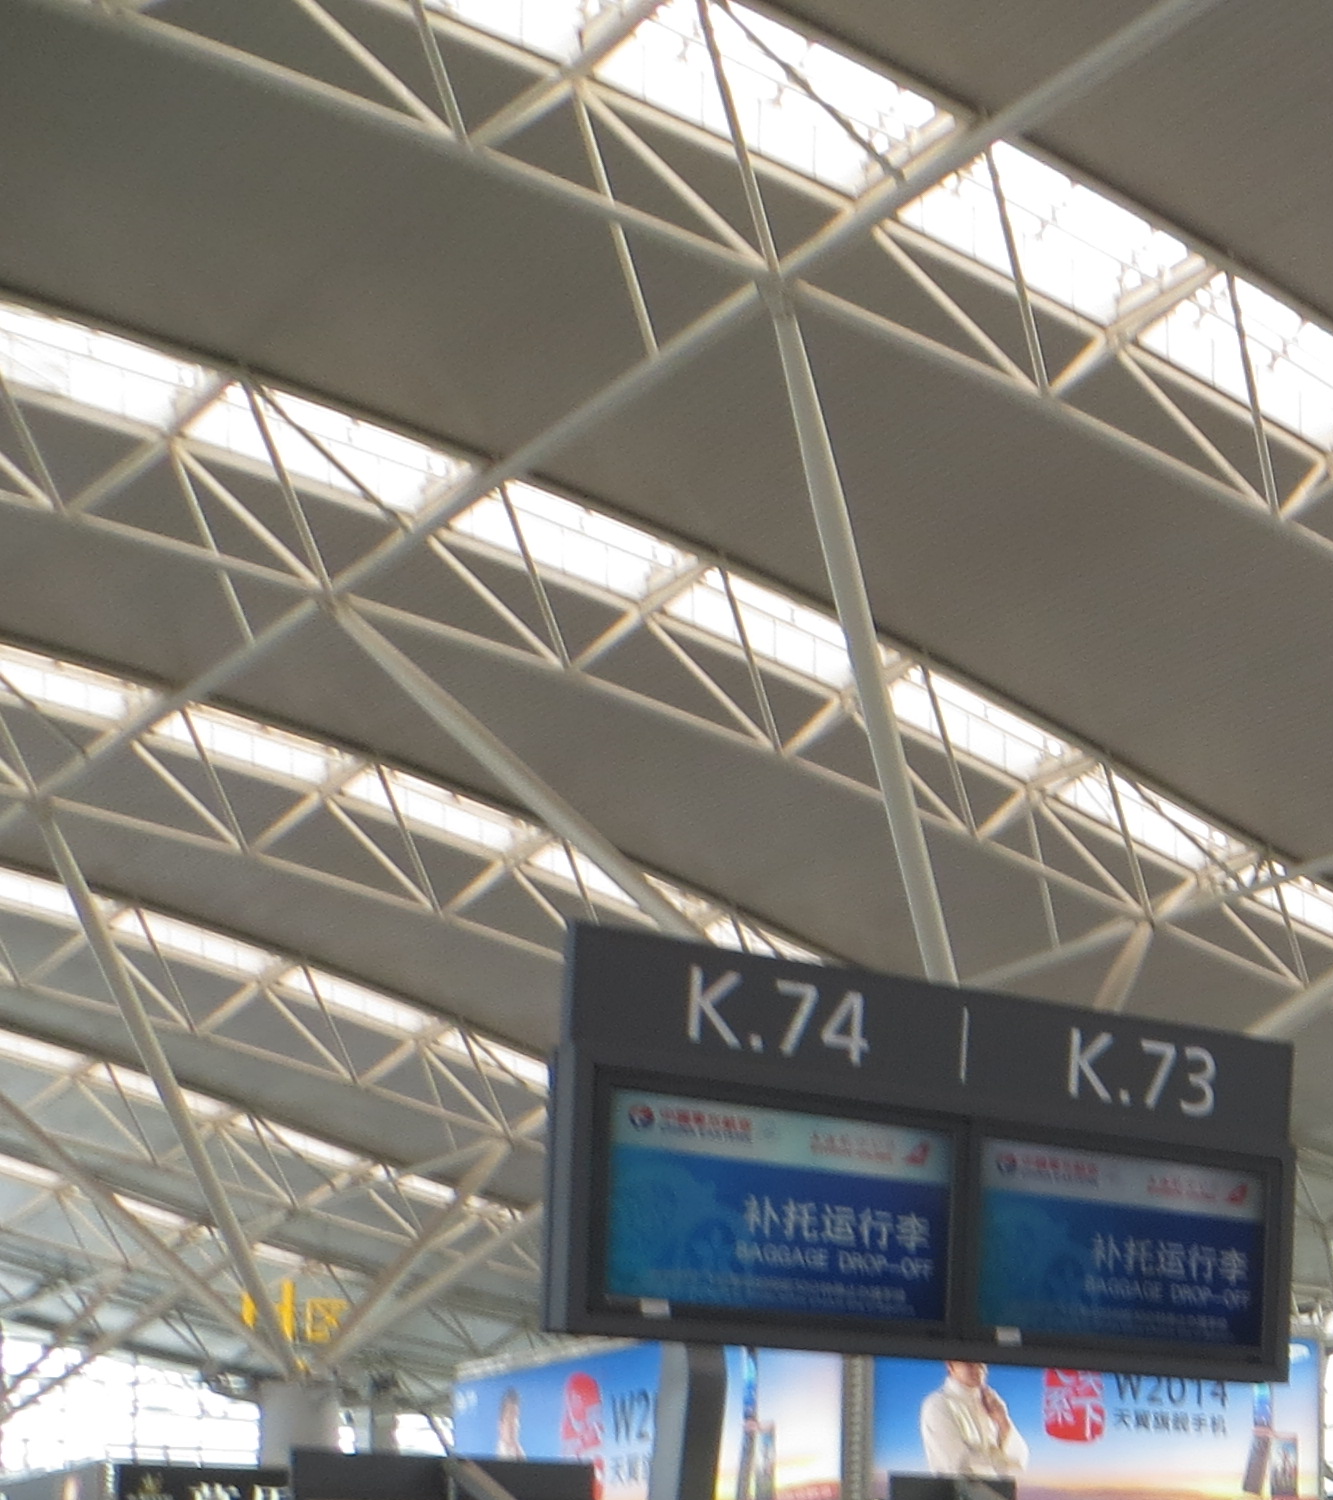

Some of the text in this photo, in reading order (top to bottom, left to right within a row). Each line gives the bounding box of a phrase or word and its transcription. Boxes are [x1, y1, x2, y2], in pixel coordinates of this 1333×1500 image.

[686, 963, 869, 1067] K.74
[1067, 1026, 1218, 1118] K.73
[735, 1239, 829, 1271] BAGGAGE
[612, 1388, 657, 1443] W2
[1113, 1373, 1228, 1408] W2014
